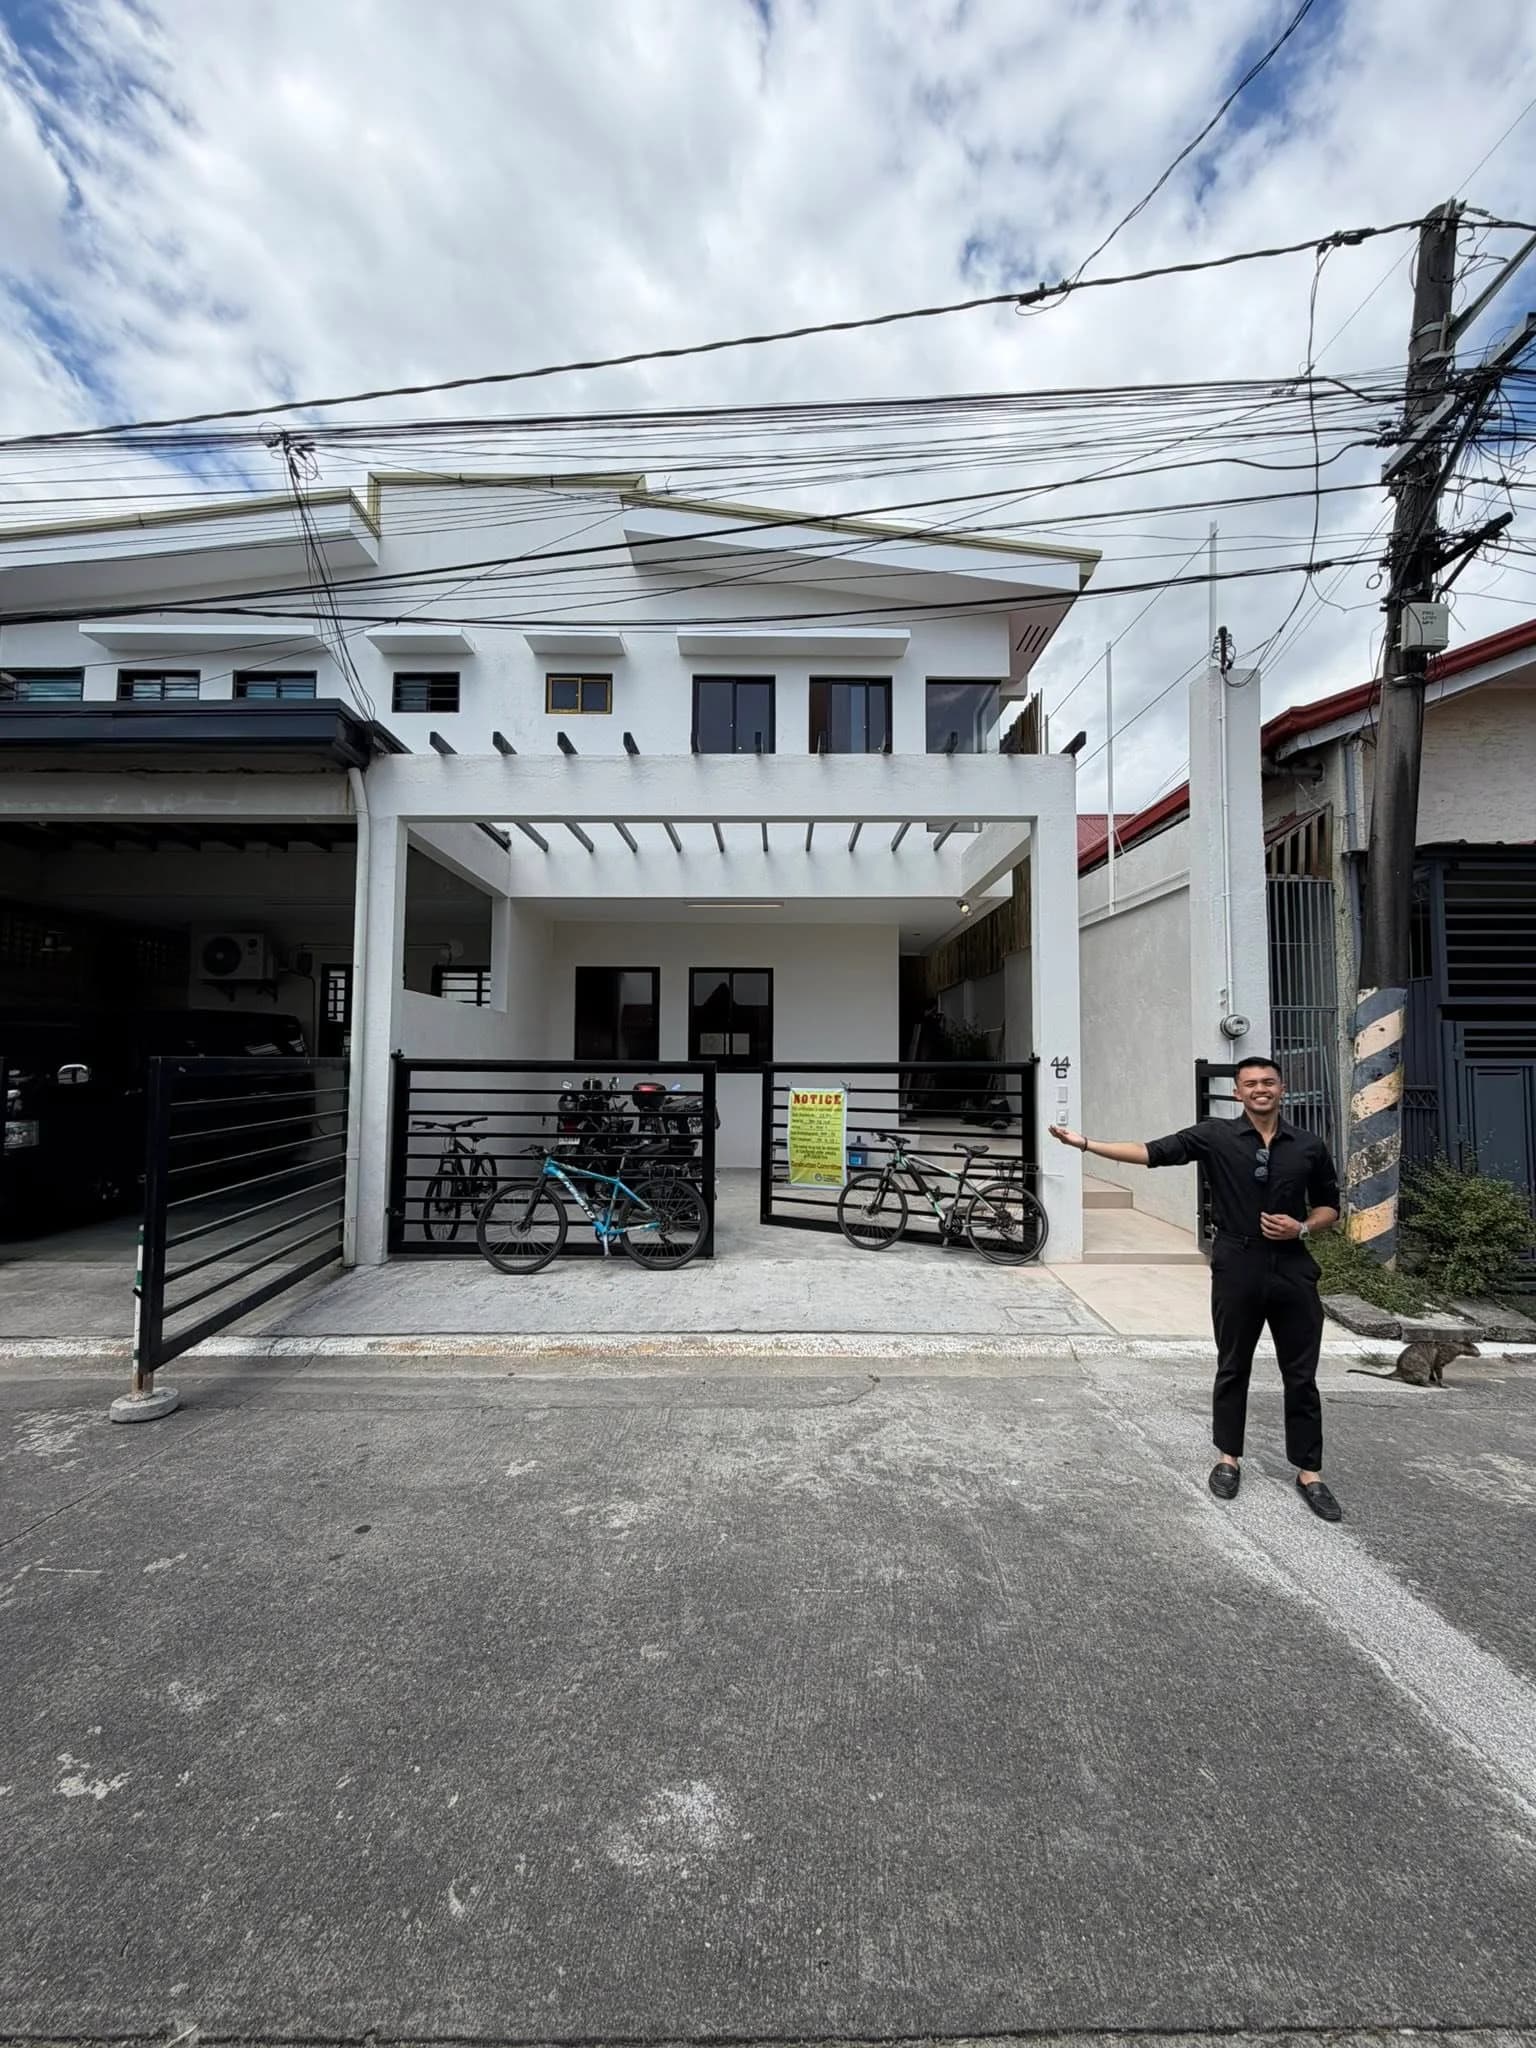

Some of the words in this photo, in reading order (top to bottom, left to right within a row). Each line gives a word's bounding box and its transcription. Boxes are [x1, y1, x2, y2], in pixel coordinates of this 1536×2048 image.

[1050, 1055, 1071, 1068] 44
[1055, 1067, 1068, 1079] C
[793, 1094, 841, 1105] NOTICE
